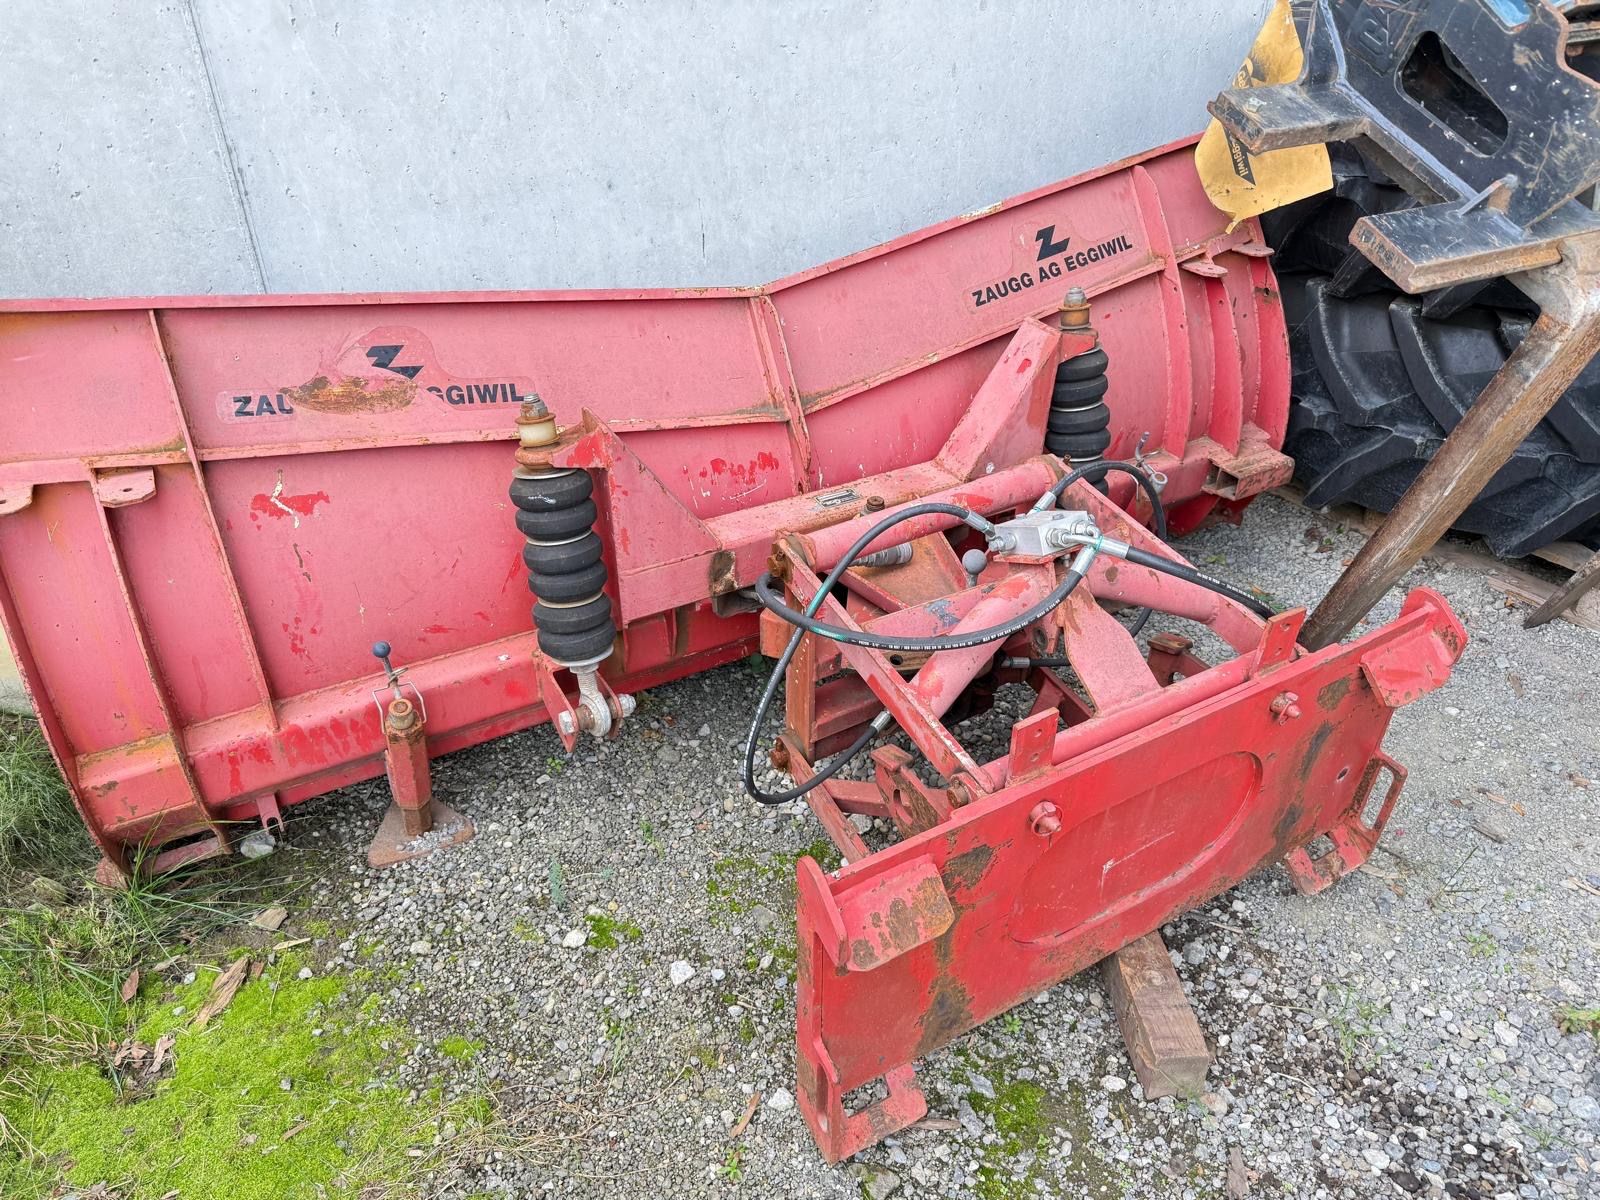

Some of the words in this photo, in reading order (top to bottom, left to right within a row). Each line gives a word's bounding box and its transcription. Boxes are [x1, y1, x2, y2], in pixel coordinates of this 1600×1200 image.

[971, 272, 1034, 307] ZAUGG
[1038, 261, 1062, 283] AG
[1063, 235, 1133, 271] EGGIWIL
[232, 393, 293, 417] ZAU
[426, 382, 524, 405] GIWIL
